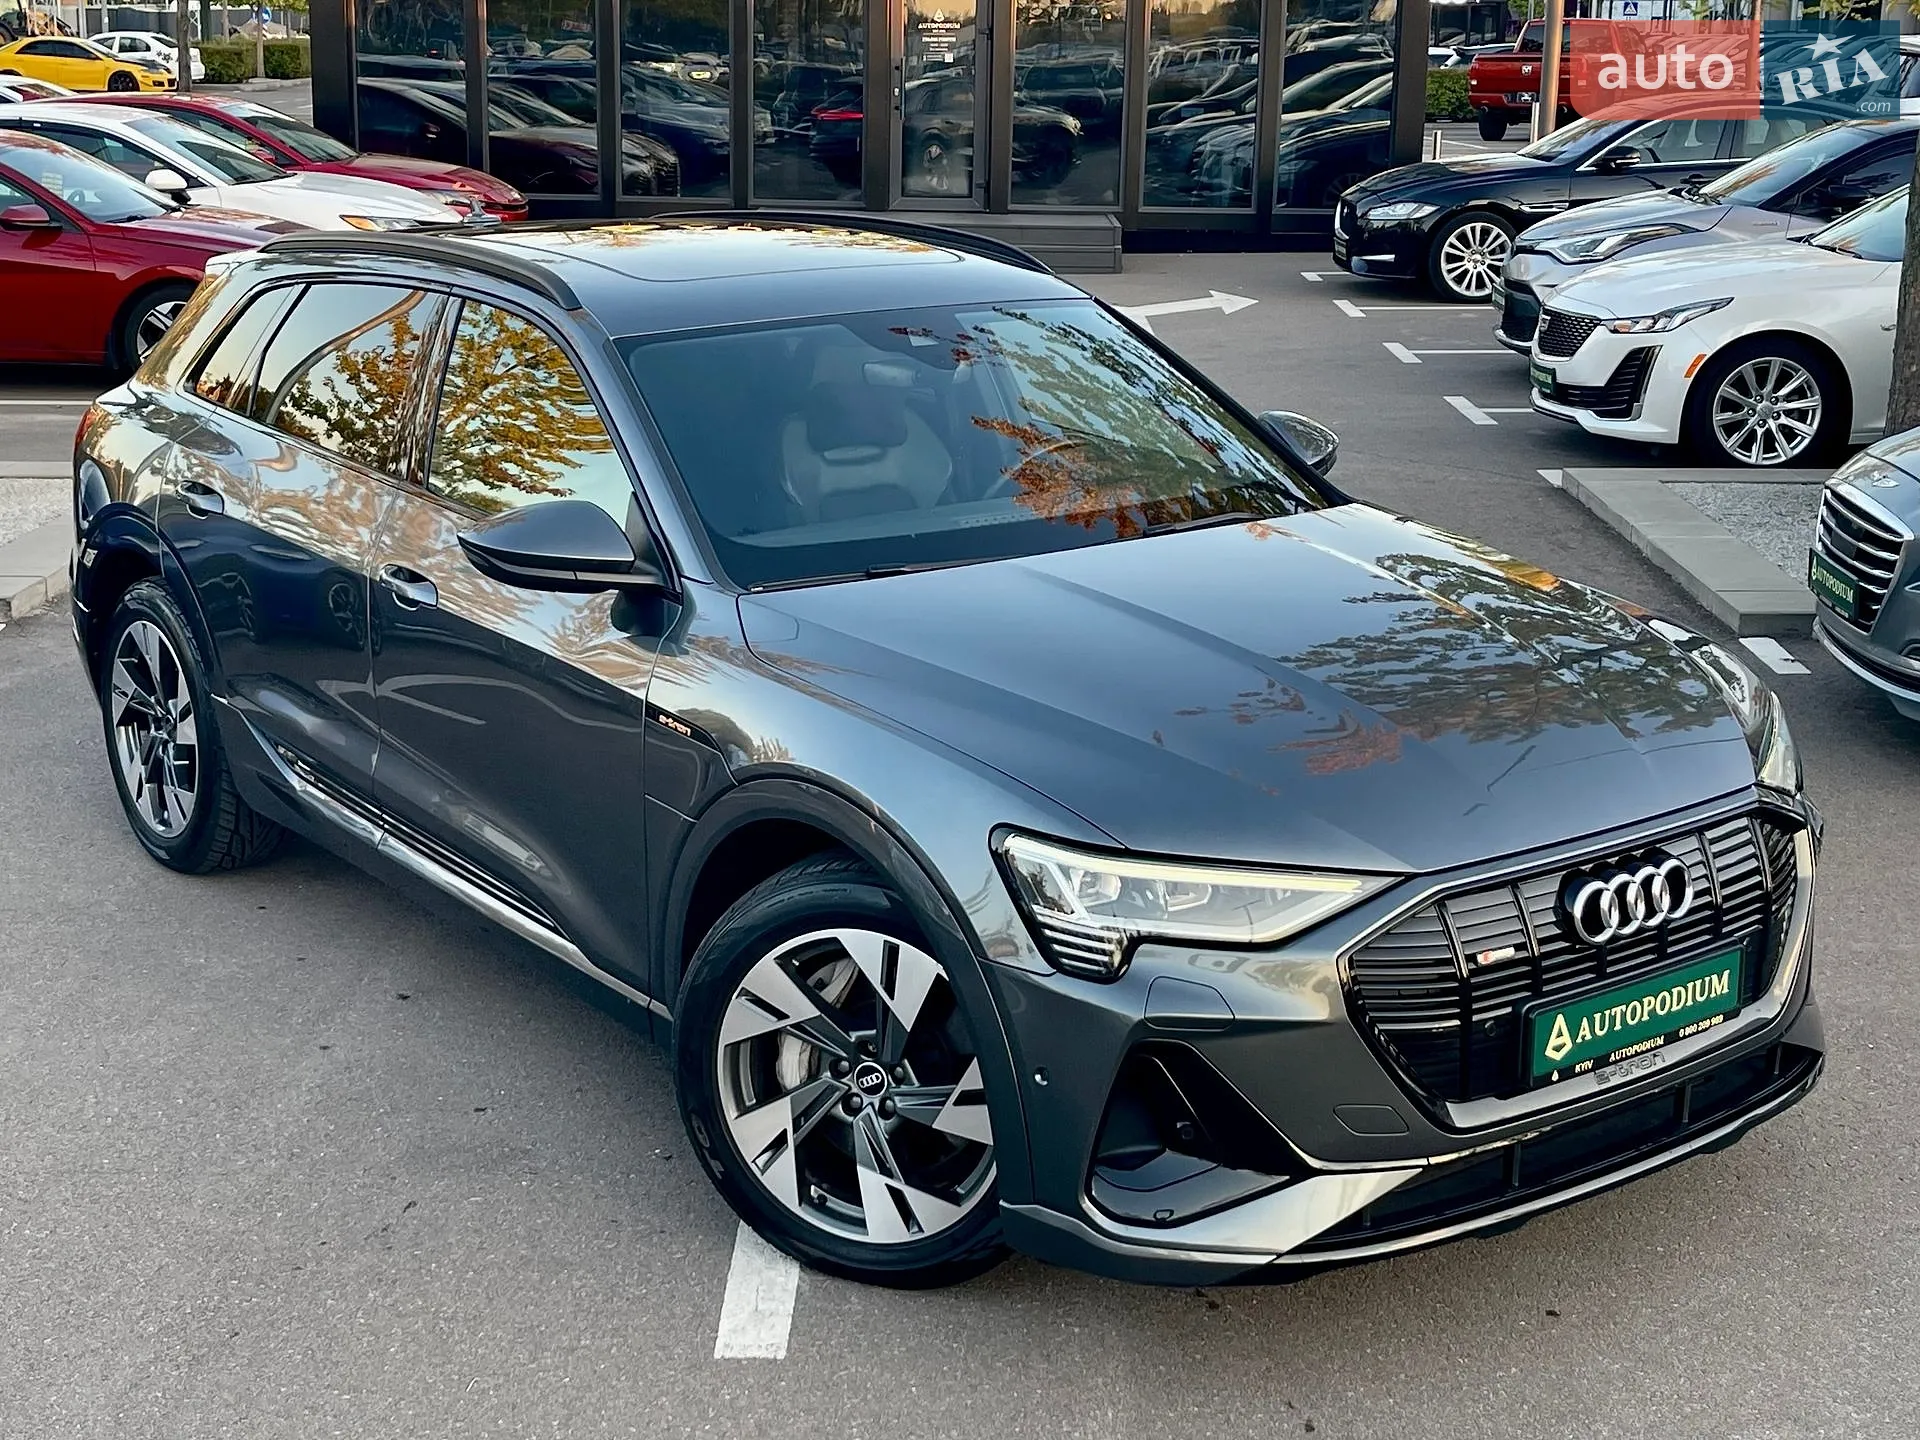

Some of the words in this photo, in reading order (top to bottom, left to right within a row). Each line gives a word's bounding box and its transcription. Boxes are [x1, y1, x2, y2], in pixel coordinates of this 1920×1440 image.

[1575, 969, 1730, 1044] AUTOPODIUM
[1574, 1059, 1594, 1073] KYIV
[1608, 1035, 1665, 1062] AUTOPODIUM
[1594, 1051, 1666, 1086] e-tron
